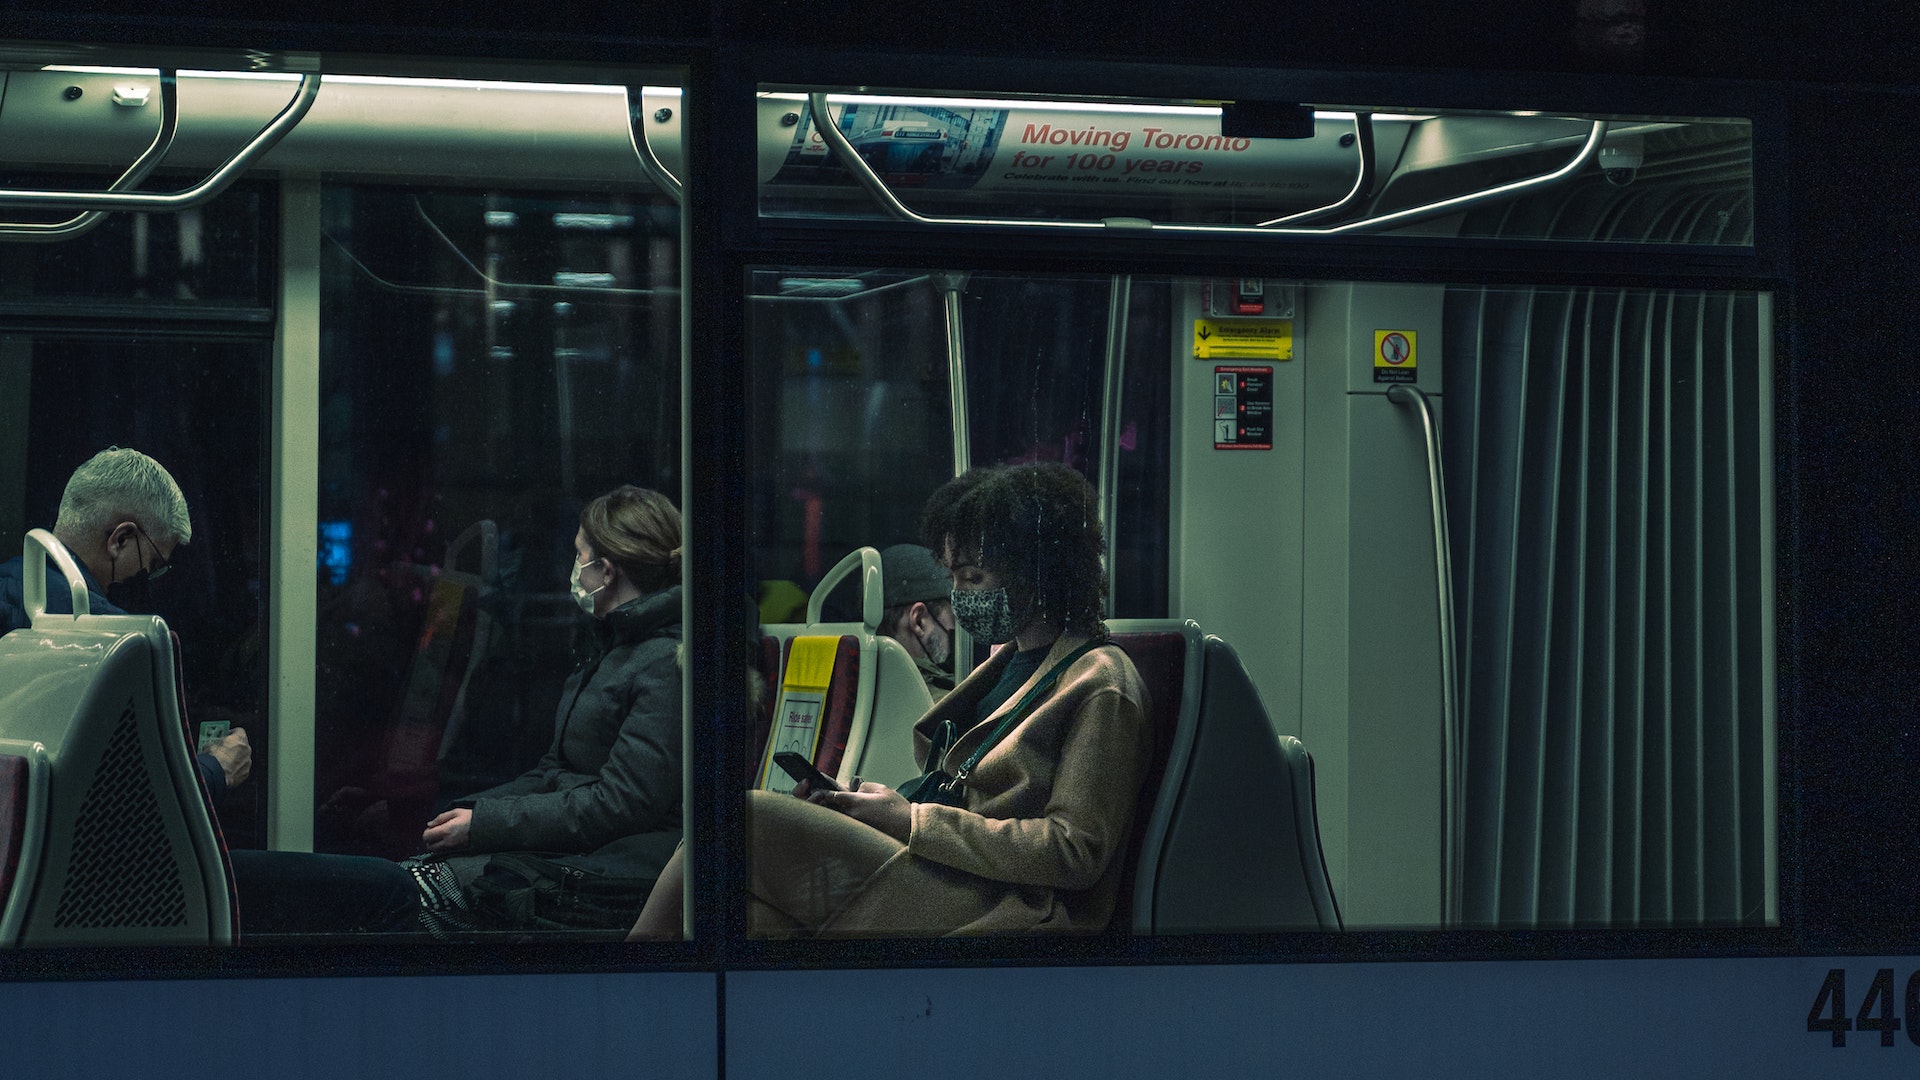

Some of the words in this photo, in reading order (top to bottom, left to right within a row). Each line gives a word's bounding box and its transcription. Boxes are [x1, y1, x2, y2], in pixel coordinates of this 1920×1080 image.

[1021, 123, 1131, 152] Moving
[1143, 127, 1251, 152] Toronto
[1011, 151, 1055, 169] for
[1066, 153, 1116, 171] 100
[1121, 157, 1204, 175] years
[1003, 172, 1069, 182] Celebrate
[1072, 174, 1100, 183] with
[1126, 176, 1156, 185] Find
[1159, 177, 1181, 185] out
[1183, 178, 1213, 186] how
[1219, 326, 1258, 335] Emergency
[1260, 327, 1281, 335] Alarm
[790, 711, 800, 723] Ride
